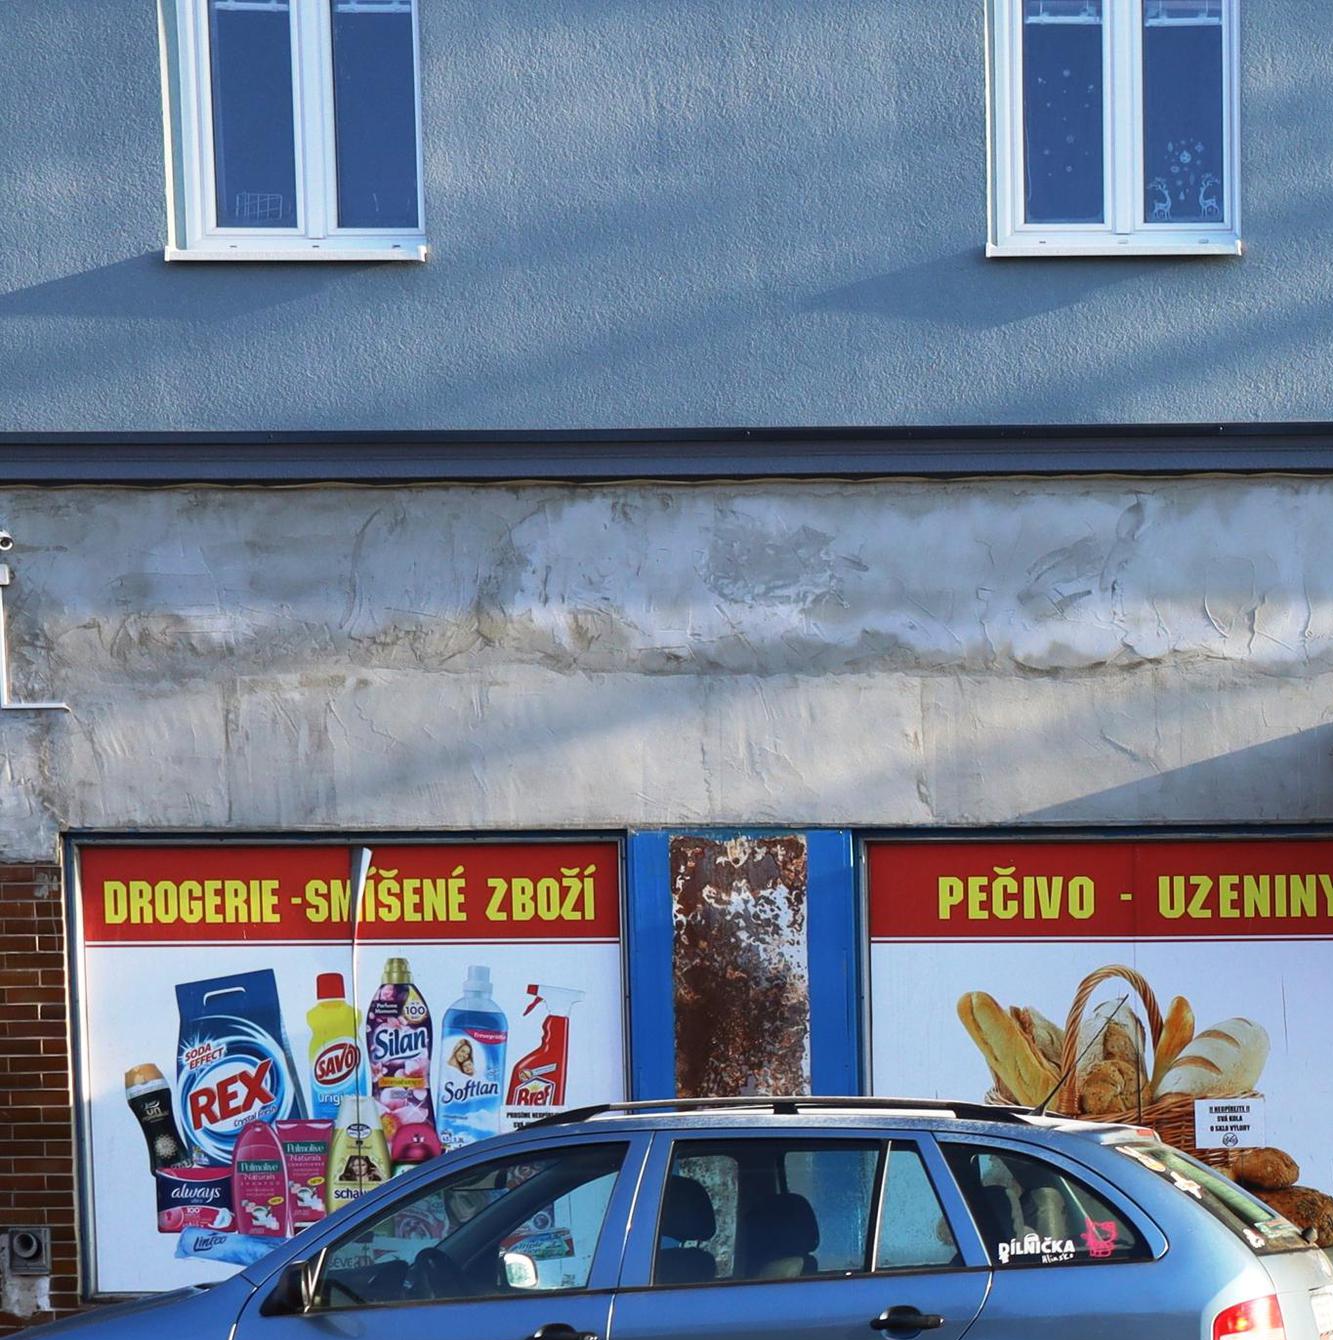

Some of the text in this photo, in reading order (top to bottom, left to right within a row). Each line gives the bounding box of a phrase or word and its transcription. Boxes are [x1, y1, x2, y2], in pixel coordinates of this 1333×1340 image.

[103, 880, 281, 924] DROGERIE
[485, 864, 597, 921] ZBOŽÍ
[938, 866, 1095, 920] PEČIVO
[405, 1006, 426, 1015] 100
[184, 1043, 212, 1062] SODA
[373, 1028, 427, 1060] Silan
[189, 1047, 225, 1070] EFFECT
[317, 1047, 354, 1080] SAVO
[189, 1058, 276, 1131] REX
[442, 1079, 499, 1105] Softlan
[519, 1085, 552, 1106] Bref
[287, 1143, 325, 1153] Palmolive
[240, 1161, 280, 1172] Palmolive
[171, 1183, 222, 1203] always
